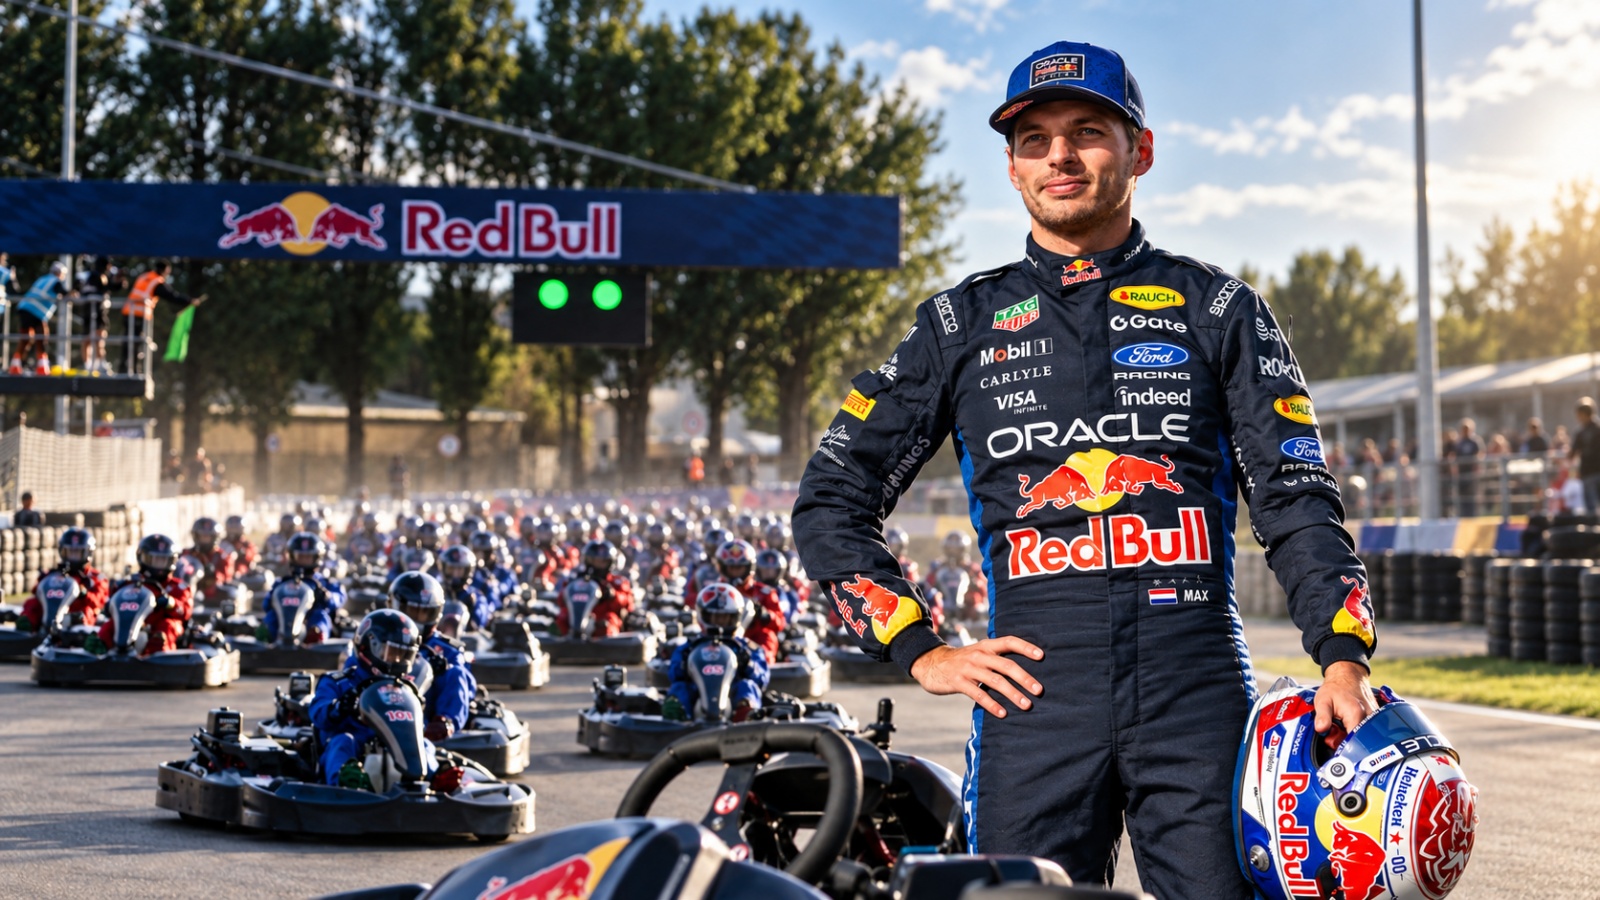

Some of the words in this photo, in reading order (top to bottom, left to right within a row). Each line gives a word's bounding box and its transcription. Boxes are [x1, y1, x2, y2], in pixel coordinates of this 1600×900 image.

[402, 200, 515, 257] Red
[518, 202, 621, 259] Bull
[1130, 291, 1176, 303] RAUCH
[997, 299, 1038, 318] TAG
[994, 311, 1039, 330] HEUER
[1130, 315, 1187, 333] Gate
[980, 340, 1031, 367] Mobil
[1128, 346, 1174, 364] Ford
[980, 366, 1052, 389] CARLYLE
[1114, 371, 1191, 380] RACING
[994, 389, 1037, 410] VISA
[1117, 386, 1191, 407] indeed
[987, 412, 1191, 459] ORACLE
[1005, 514, 1106, 580] Red
[1108, 506, 1212, 569] Bull
[1184, 589, 1209, 602] MAX
[385, 710, 414, 721] 101
[1278, 771, 1311, 836] Red
[1279, 838, 1321, 897] Bull
